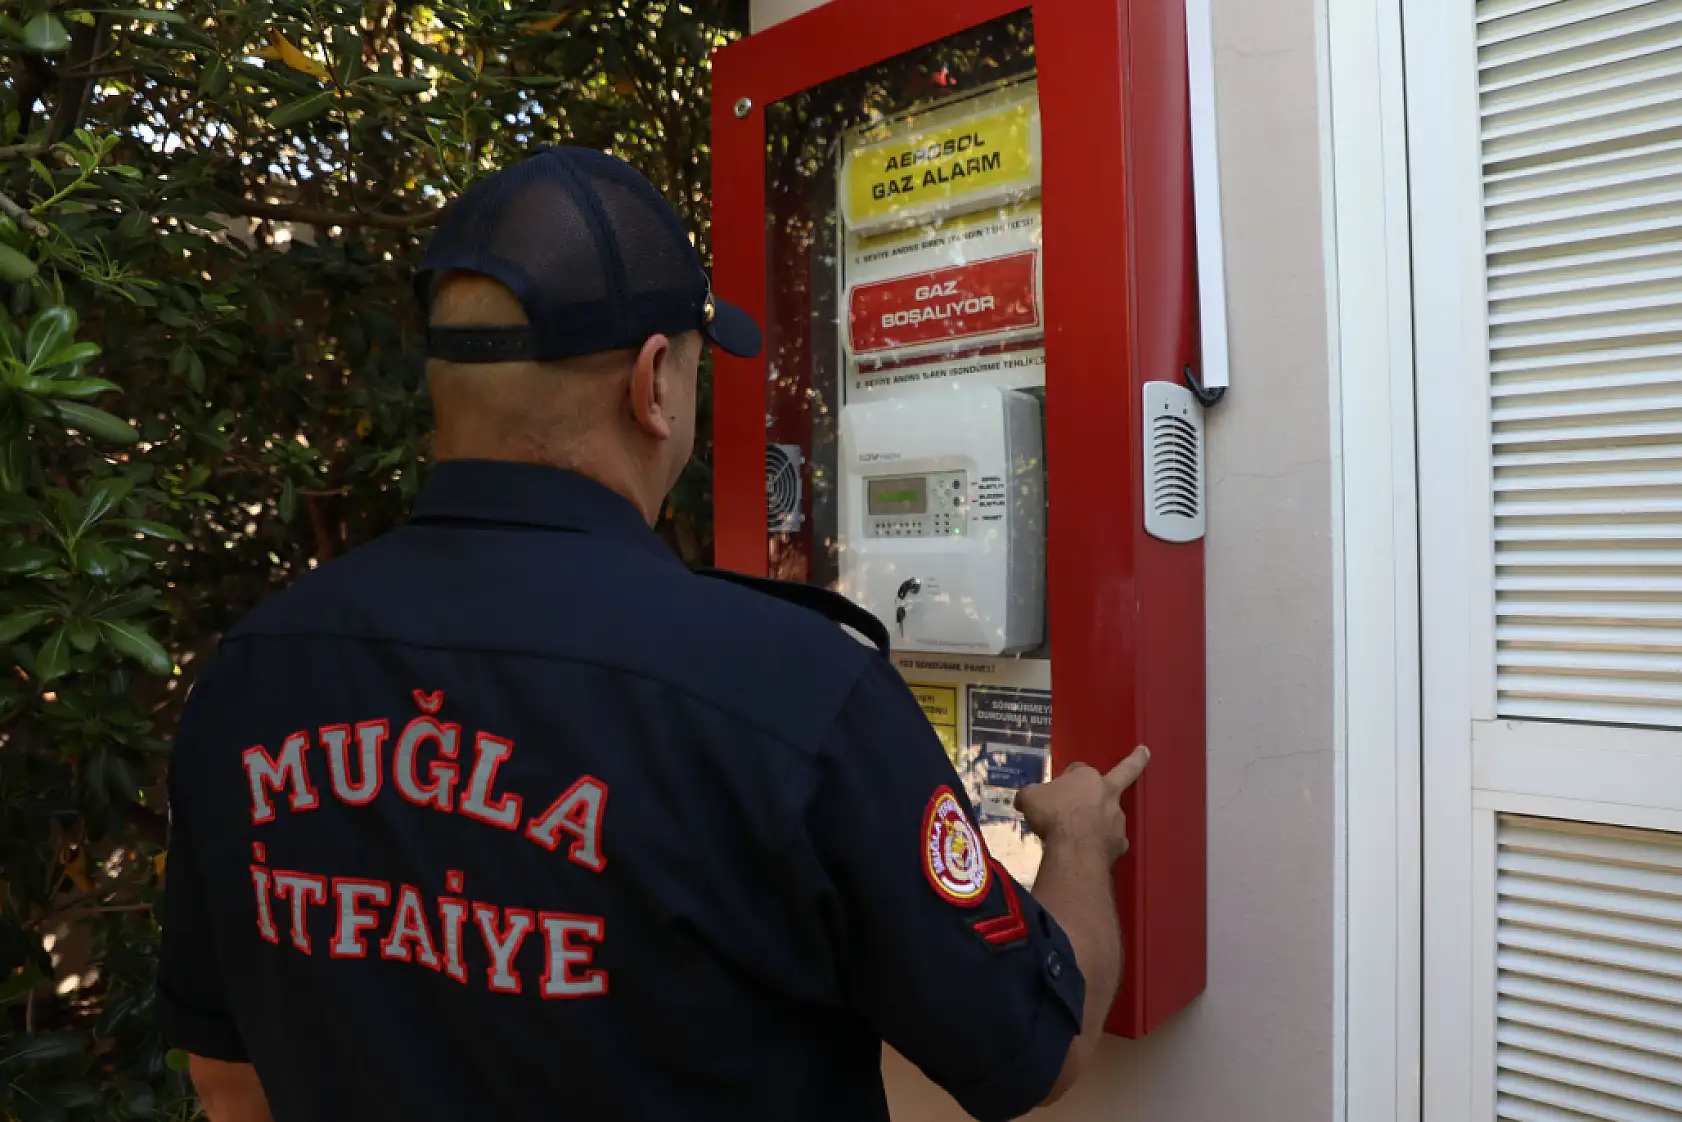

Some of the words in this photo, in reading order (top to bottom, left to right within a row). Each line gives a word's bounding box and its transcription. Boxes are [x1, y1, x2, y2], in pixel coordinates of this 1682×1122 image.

[885, 132, 985, 172] AEROSOL
[872, 175, 914, 199] GAZ
[923, 151, 1000, 188] ALARM
[881, 296, 995, 328] BOŞALIYOR
[915, 280, 958, 301] GAZ
[242, 689, 608, 872] MUĞLA
[250, 841, 608, 998] İTFAİYE
